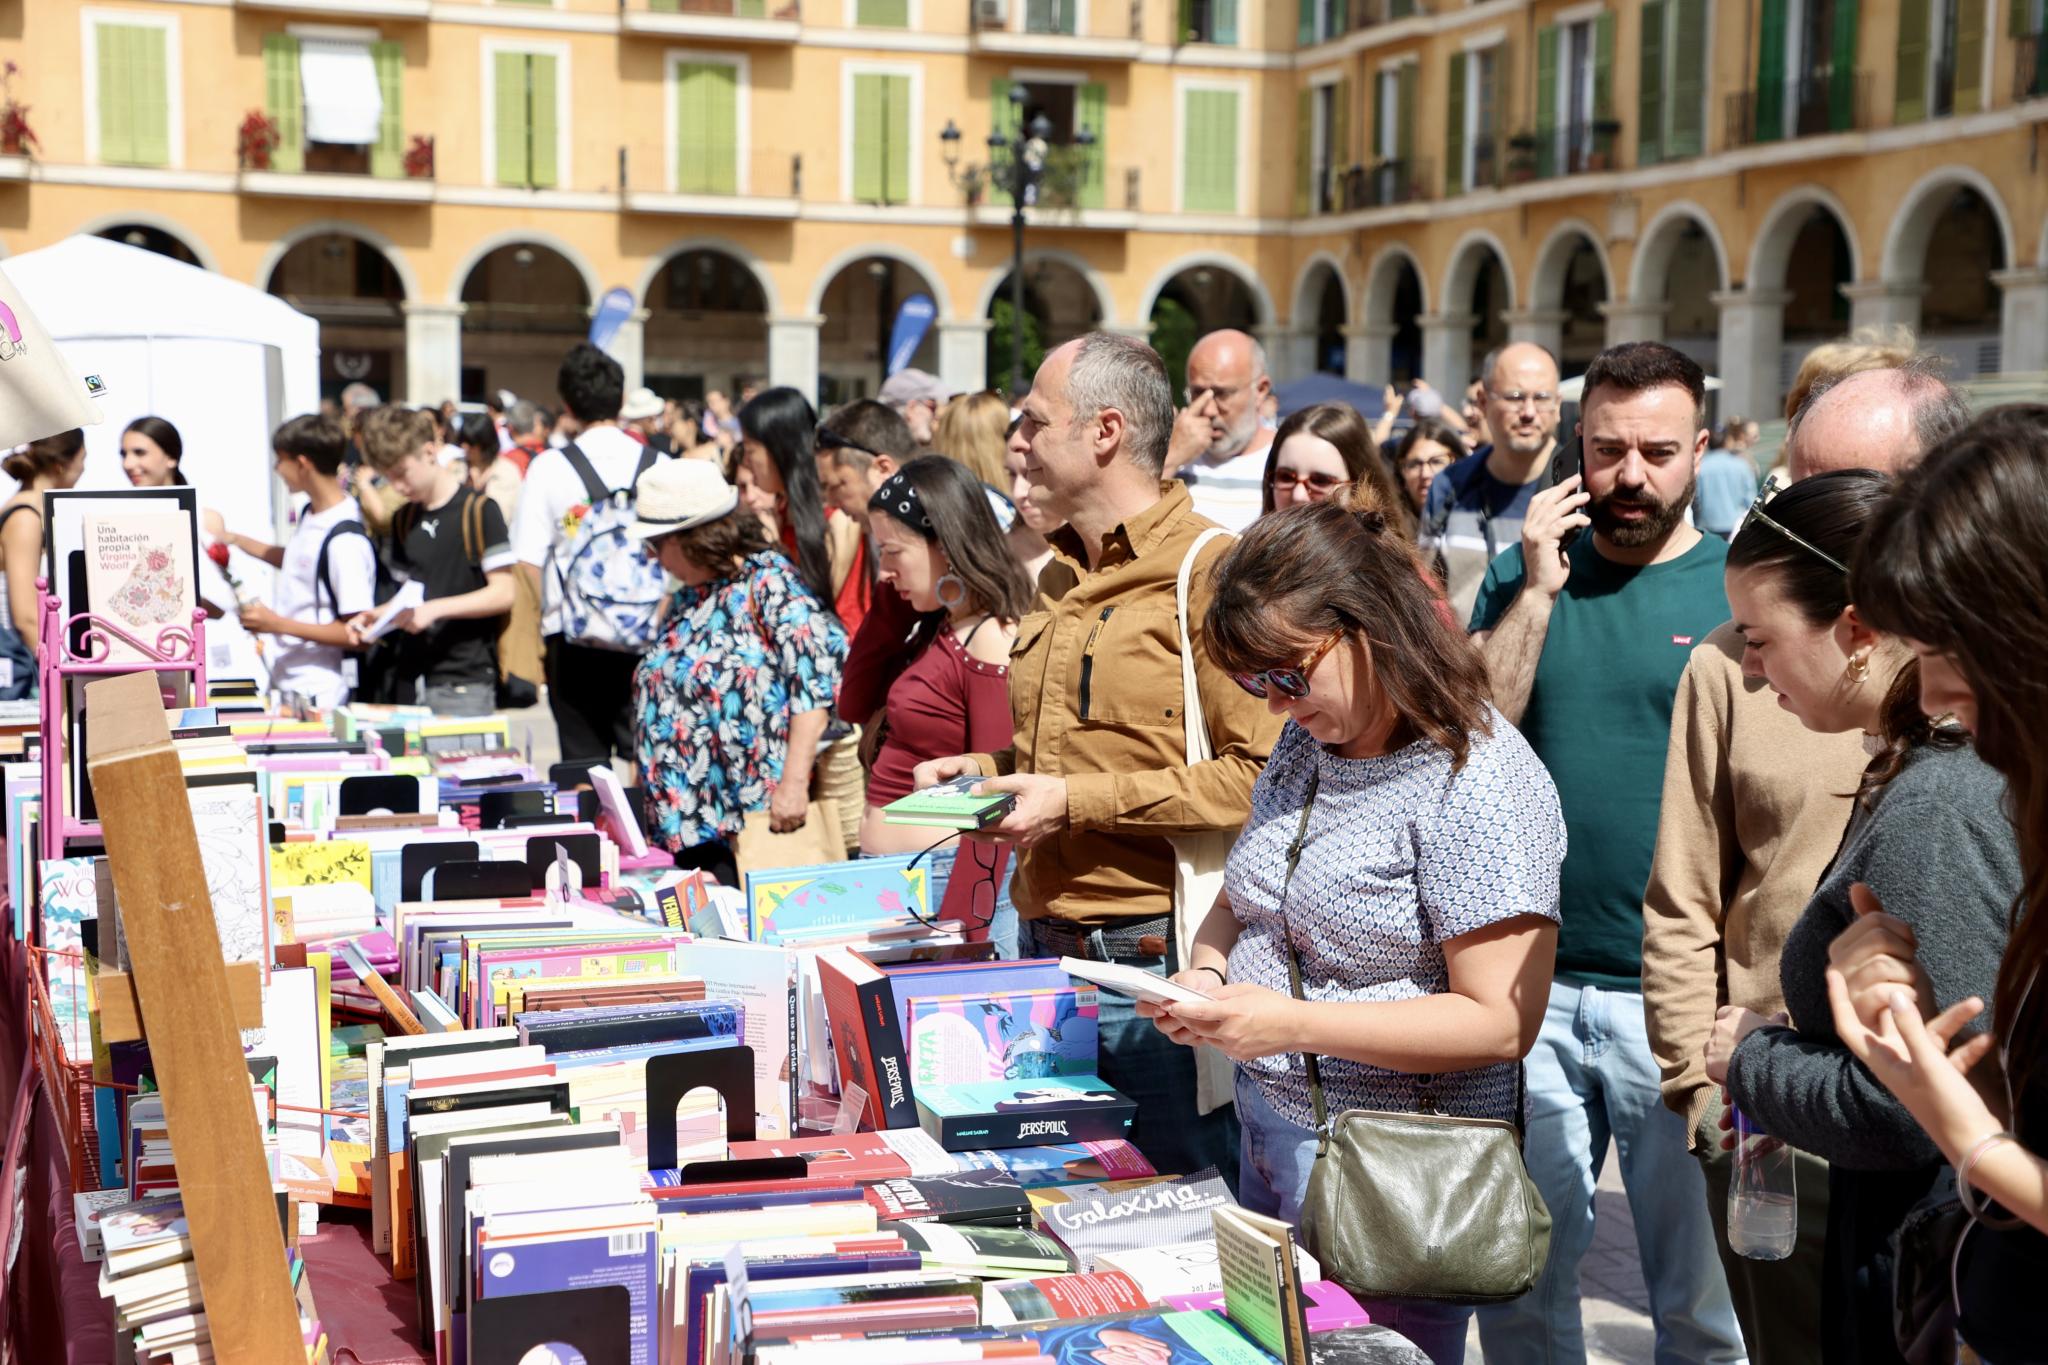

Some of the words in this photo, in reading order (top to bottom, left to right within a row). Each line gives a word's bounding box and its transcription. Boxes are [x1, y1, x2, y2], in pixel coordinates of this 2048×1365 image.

[97, 525, 117, 534] Una
[97, 533, 149, 543] habitación
[98, 543, 131, 553] propia
[99, 552, 137, 562] Virginia
[99, 561, 130, 570] Woolf
[788, 995, 796, 1015] Que
[790, 1016, 795, 1029] no
[790, 1031, 796, 1041] se
[880, 1055, 905, 1110] PERSÉPOLIS
[1017, 1119, 1070, 1140] PERSÉPOLIS
[1052, 1184, 1202, 1231] Galaxina
